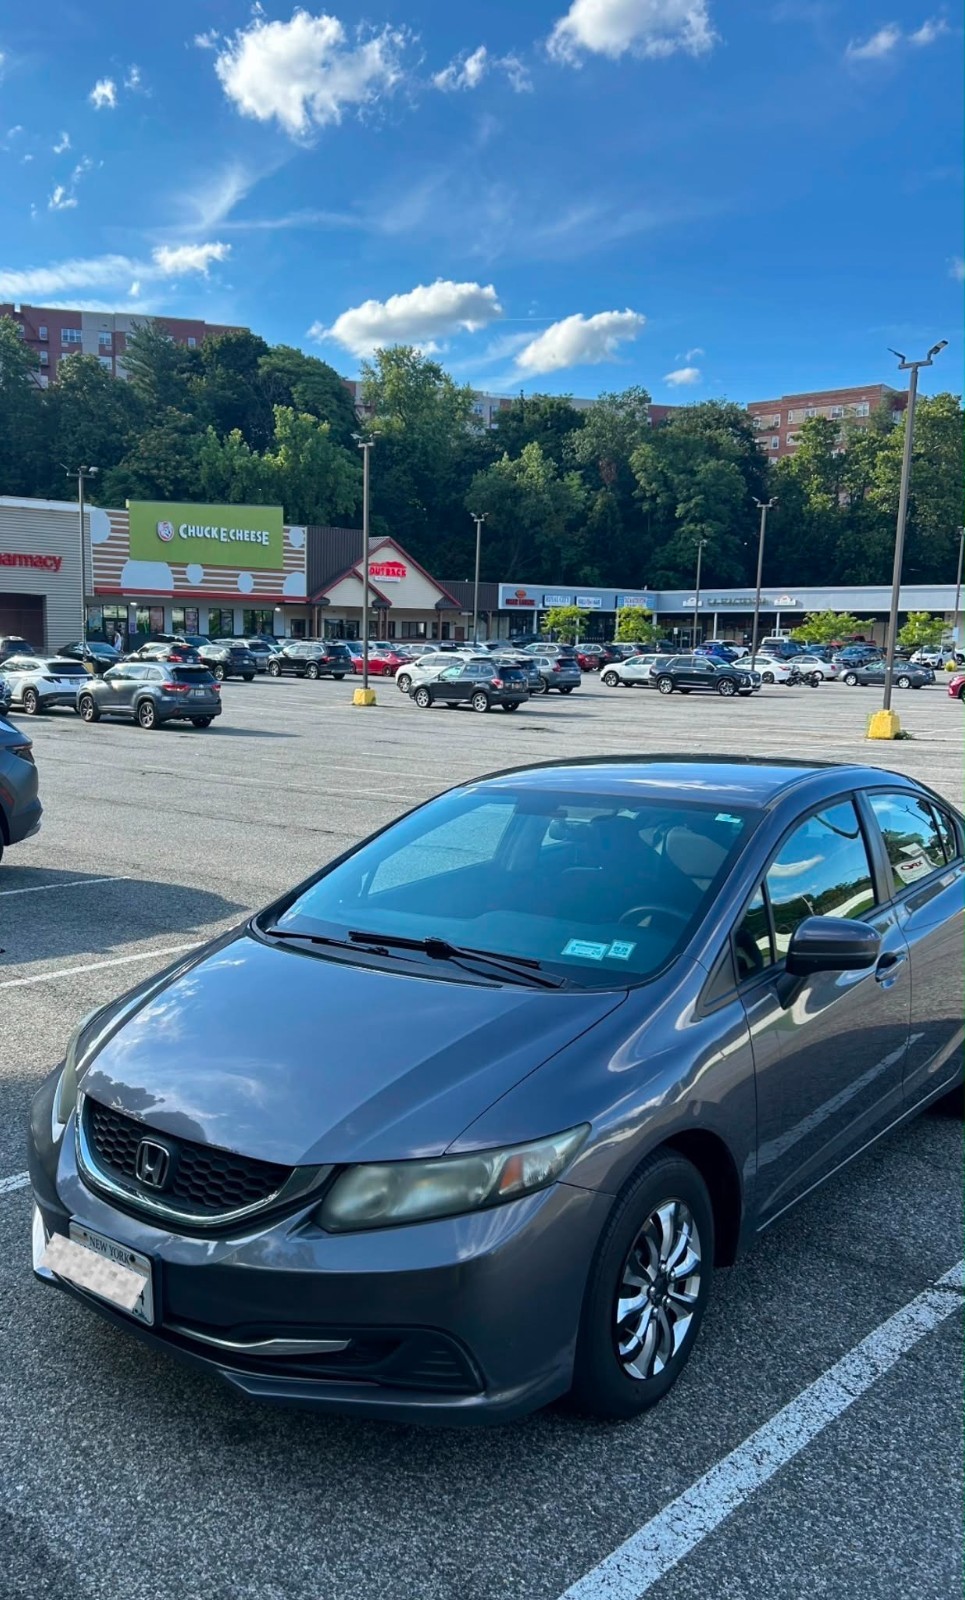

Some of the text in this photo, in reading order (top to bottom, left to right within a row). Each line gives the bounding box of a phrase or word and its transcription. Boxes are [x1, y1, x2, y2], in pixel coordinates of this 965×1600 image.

[179, 523, 219, 539] CHUCK
[229, 529, 270, 546] CHEESE
[0, 552, 62, 573] armacy
[369, 566, 407, 577] OUTBACK
[89, 1235, 130, 1265] NEW YORK
